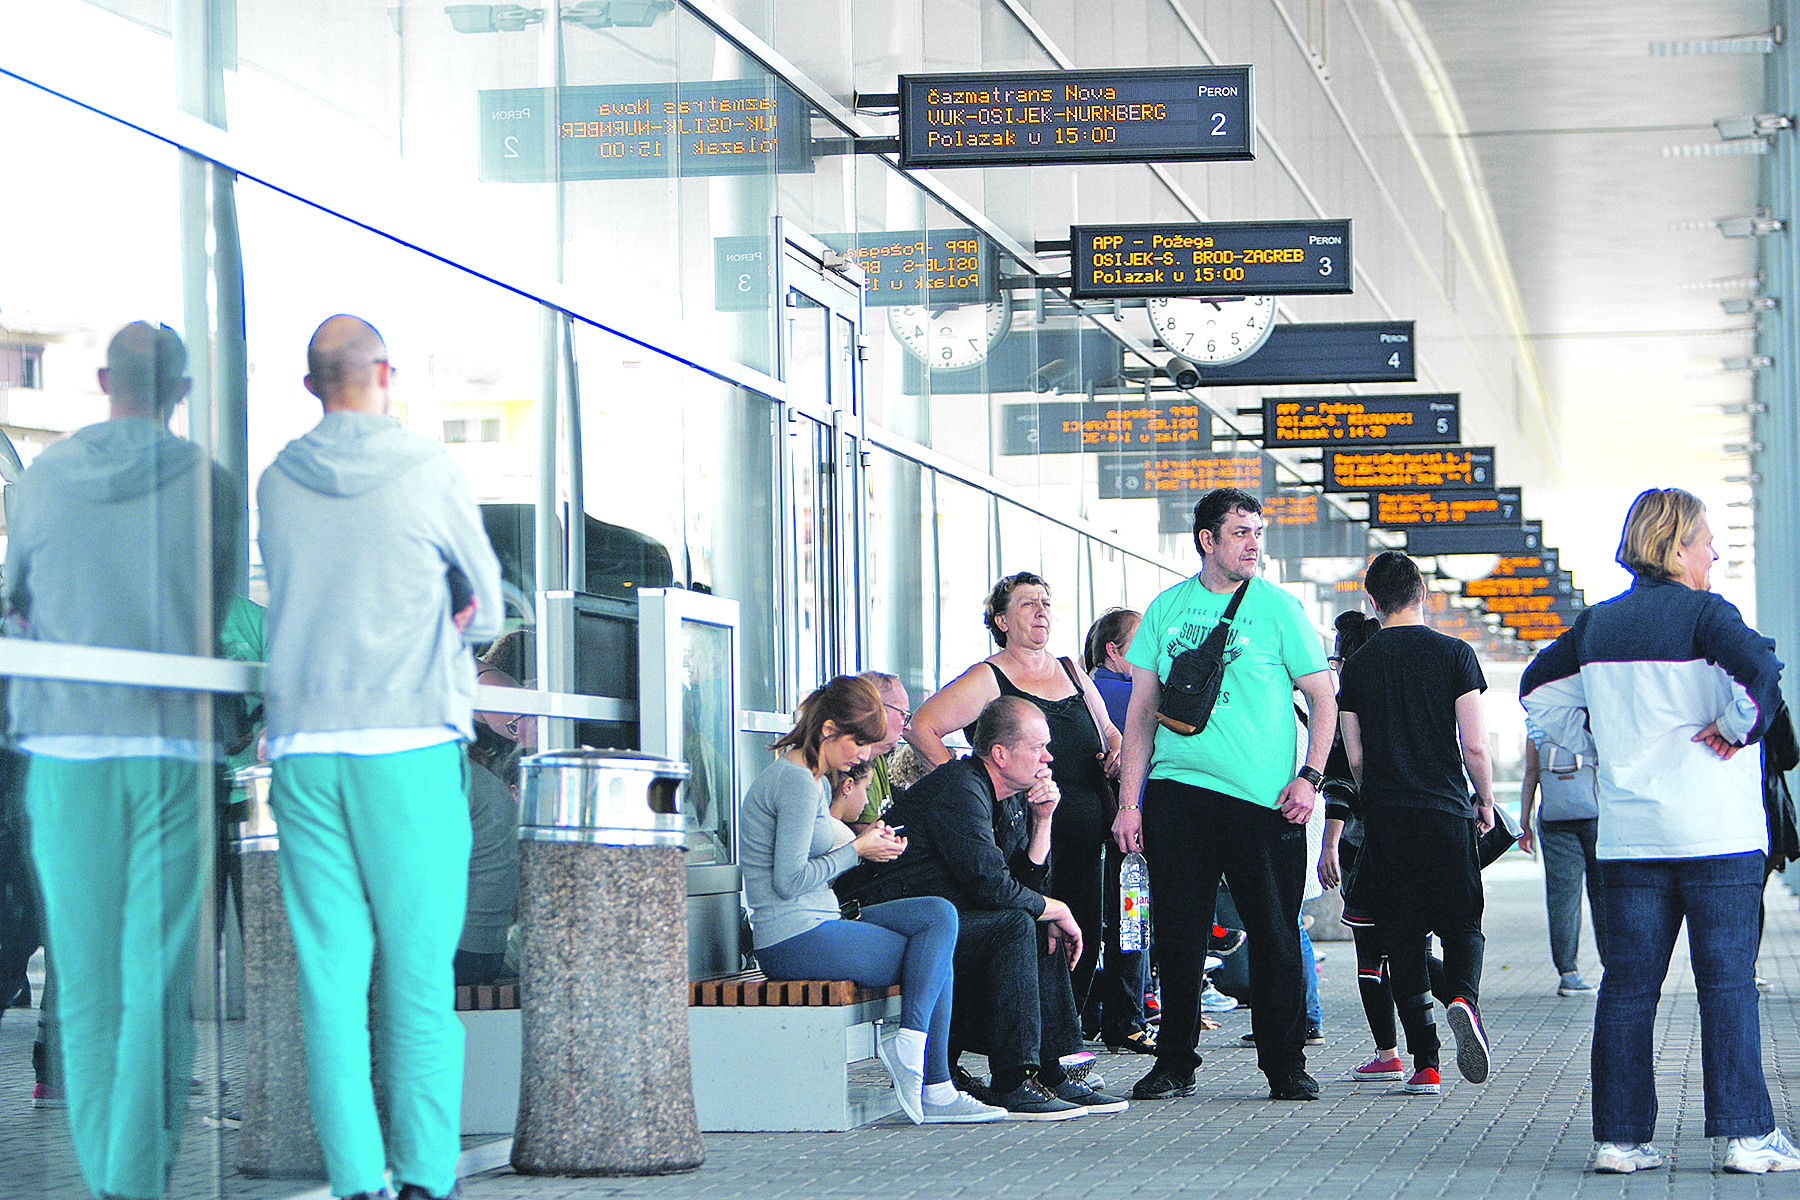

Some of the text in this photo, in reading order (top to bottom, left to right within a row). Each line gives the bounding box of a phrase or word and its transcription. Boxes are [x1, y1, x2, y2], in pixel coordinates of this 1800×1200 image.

[1065, 85, 1116, 102] Nova
[1198, 86, 1238, 98] PERON
[927, 103, 1167, 126] VUK-OSIJEK-NURNBERG
[1210, 113, 1227, 136] 2
[928, 126, 1117, 148] Polazak u 15:00
[1092, 235, 1123, 250] APP
[1153, 234, 1214, 250] Požega
[1308, 235, 1342, 245] PERON
[1093, 248, 1305, 267] OSIJEK-S. BROD-ZAGREB
[1318, 257, 1333, 276] 3
[1093, 267, 1245, 284] Polazak u 15:00
[1167, 317, 1176, 330] 8
[1246, 316, 1255, 329] 4
[1186, 333, 1194, 346] 7
[1207, 340, 1216, 352] 6
[1231, 332, 1240, 345] 5
[1387, 351, 1401, 369] 4
[1436, 417, 1449, 434] 5
[1474, 467, 1486, 482] 6
[1502, 505, 1514, 518] 7
